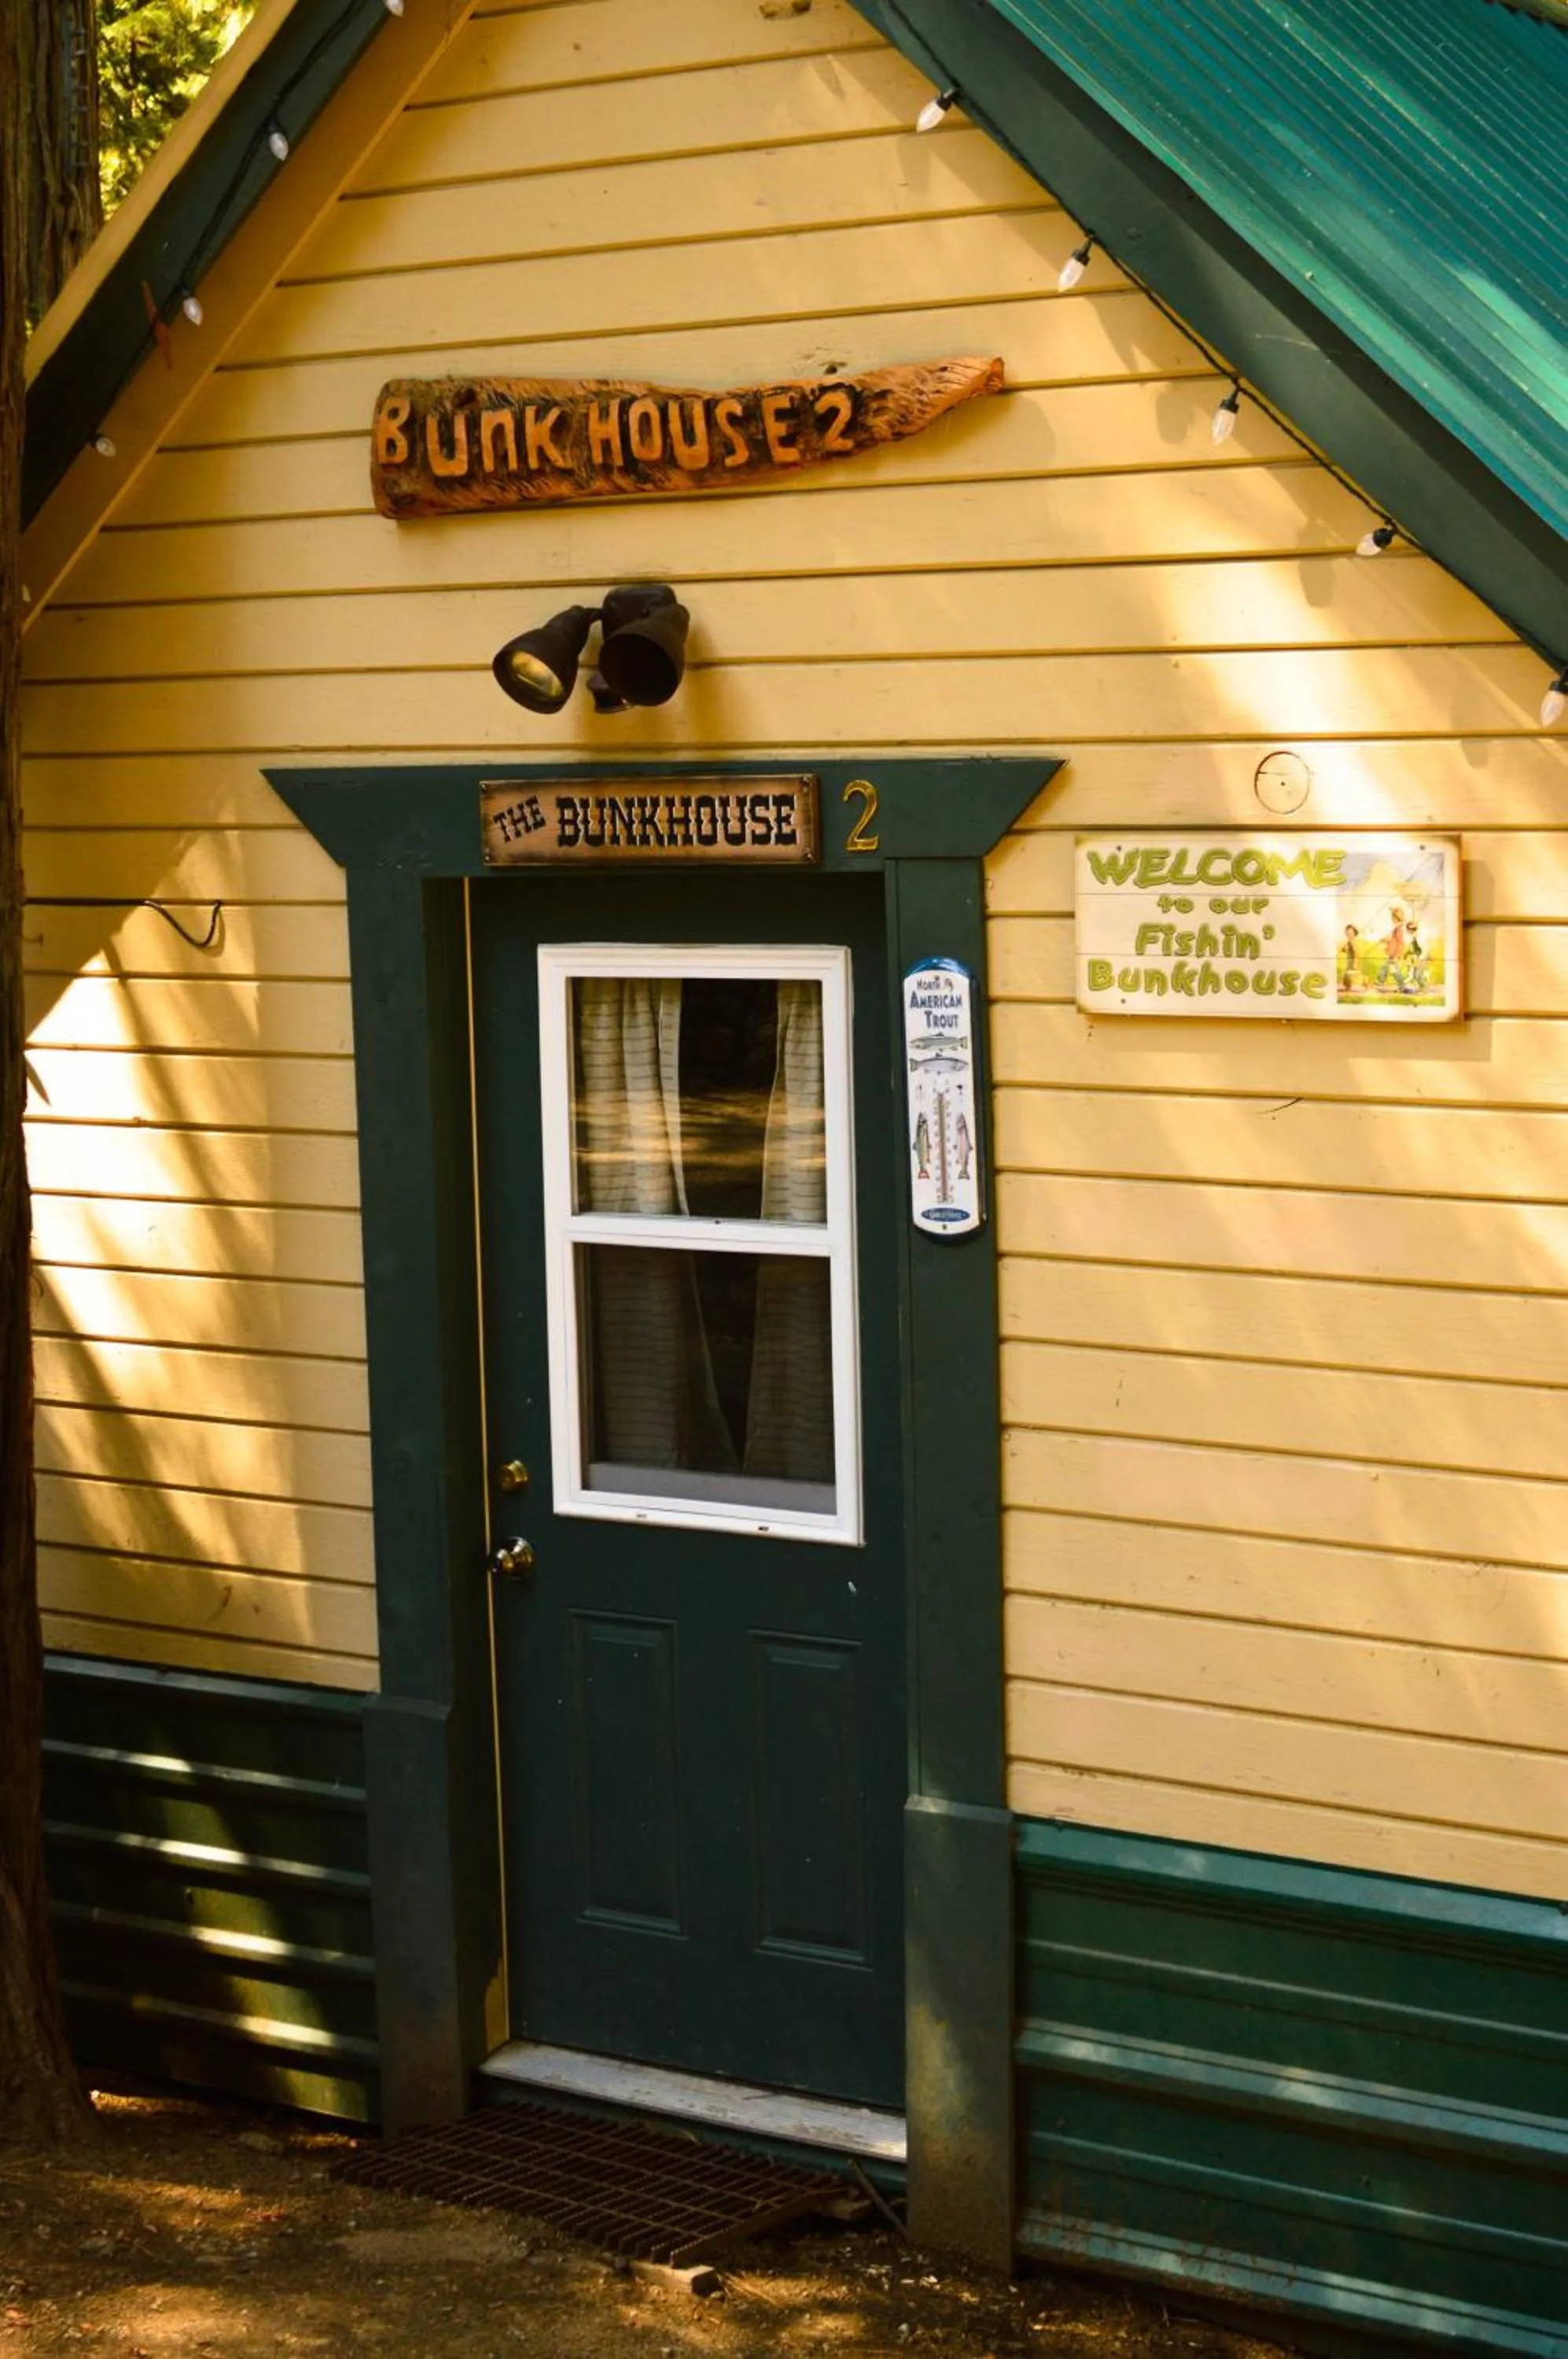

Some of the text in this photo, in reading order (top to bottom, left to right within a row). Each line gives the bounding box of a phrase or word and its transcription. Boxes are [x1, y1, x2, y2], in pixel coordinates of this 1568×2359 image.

[588, 396, 799, 469] HOUSE
[814, 391, 853, 451] 2
[493, 793, 798, 848] THE BUNKHOUSE
[842, 780, 880, 852] 2
[1087, 847, 1348, 889] WELCOME
[1157, 894, 1270, 915] to our
[1135, 922, 1276, 959] Fishin'
[1088, 959, 1329, 999] Bunkhouse
